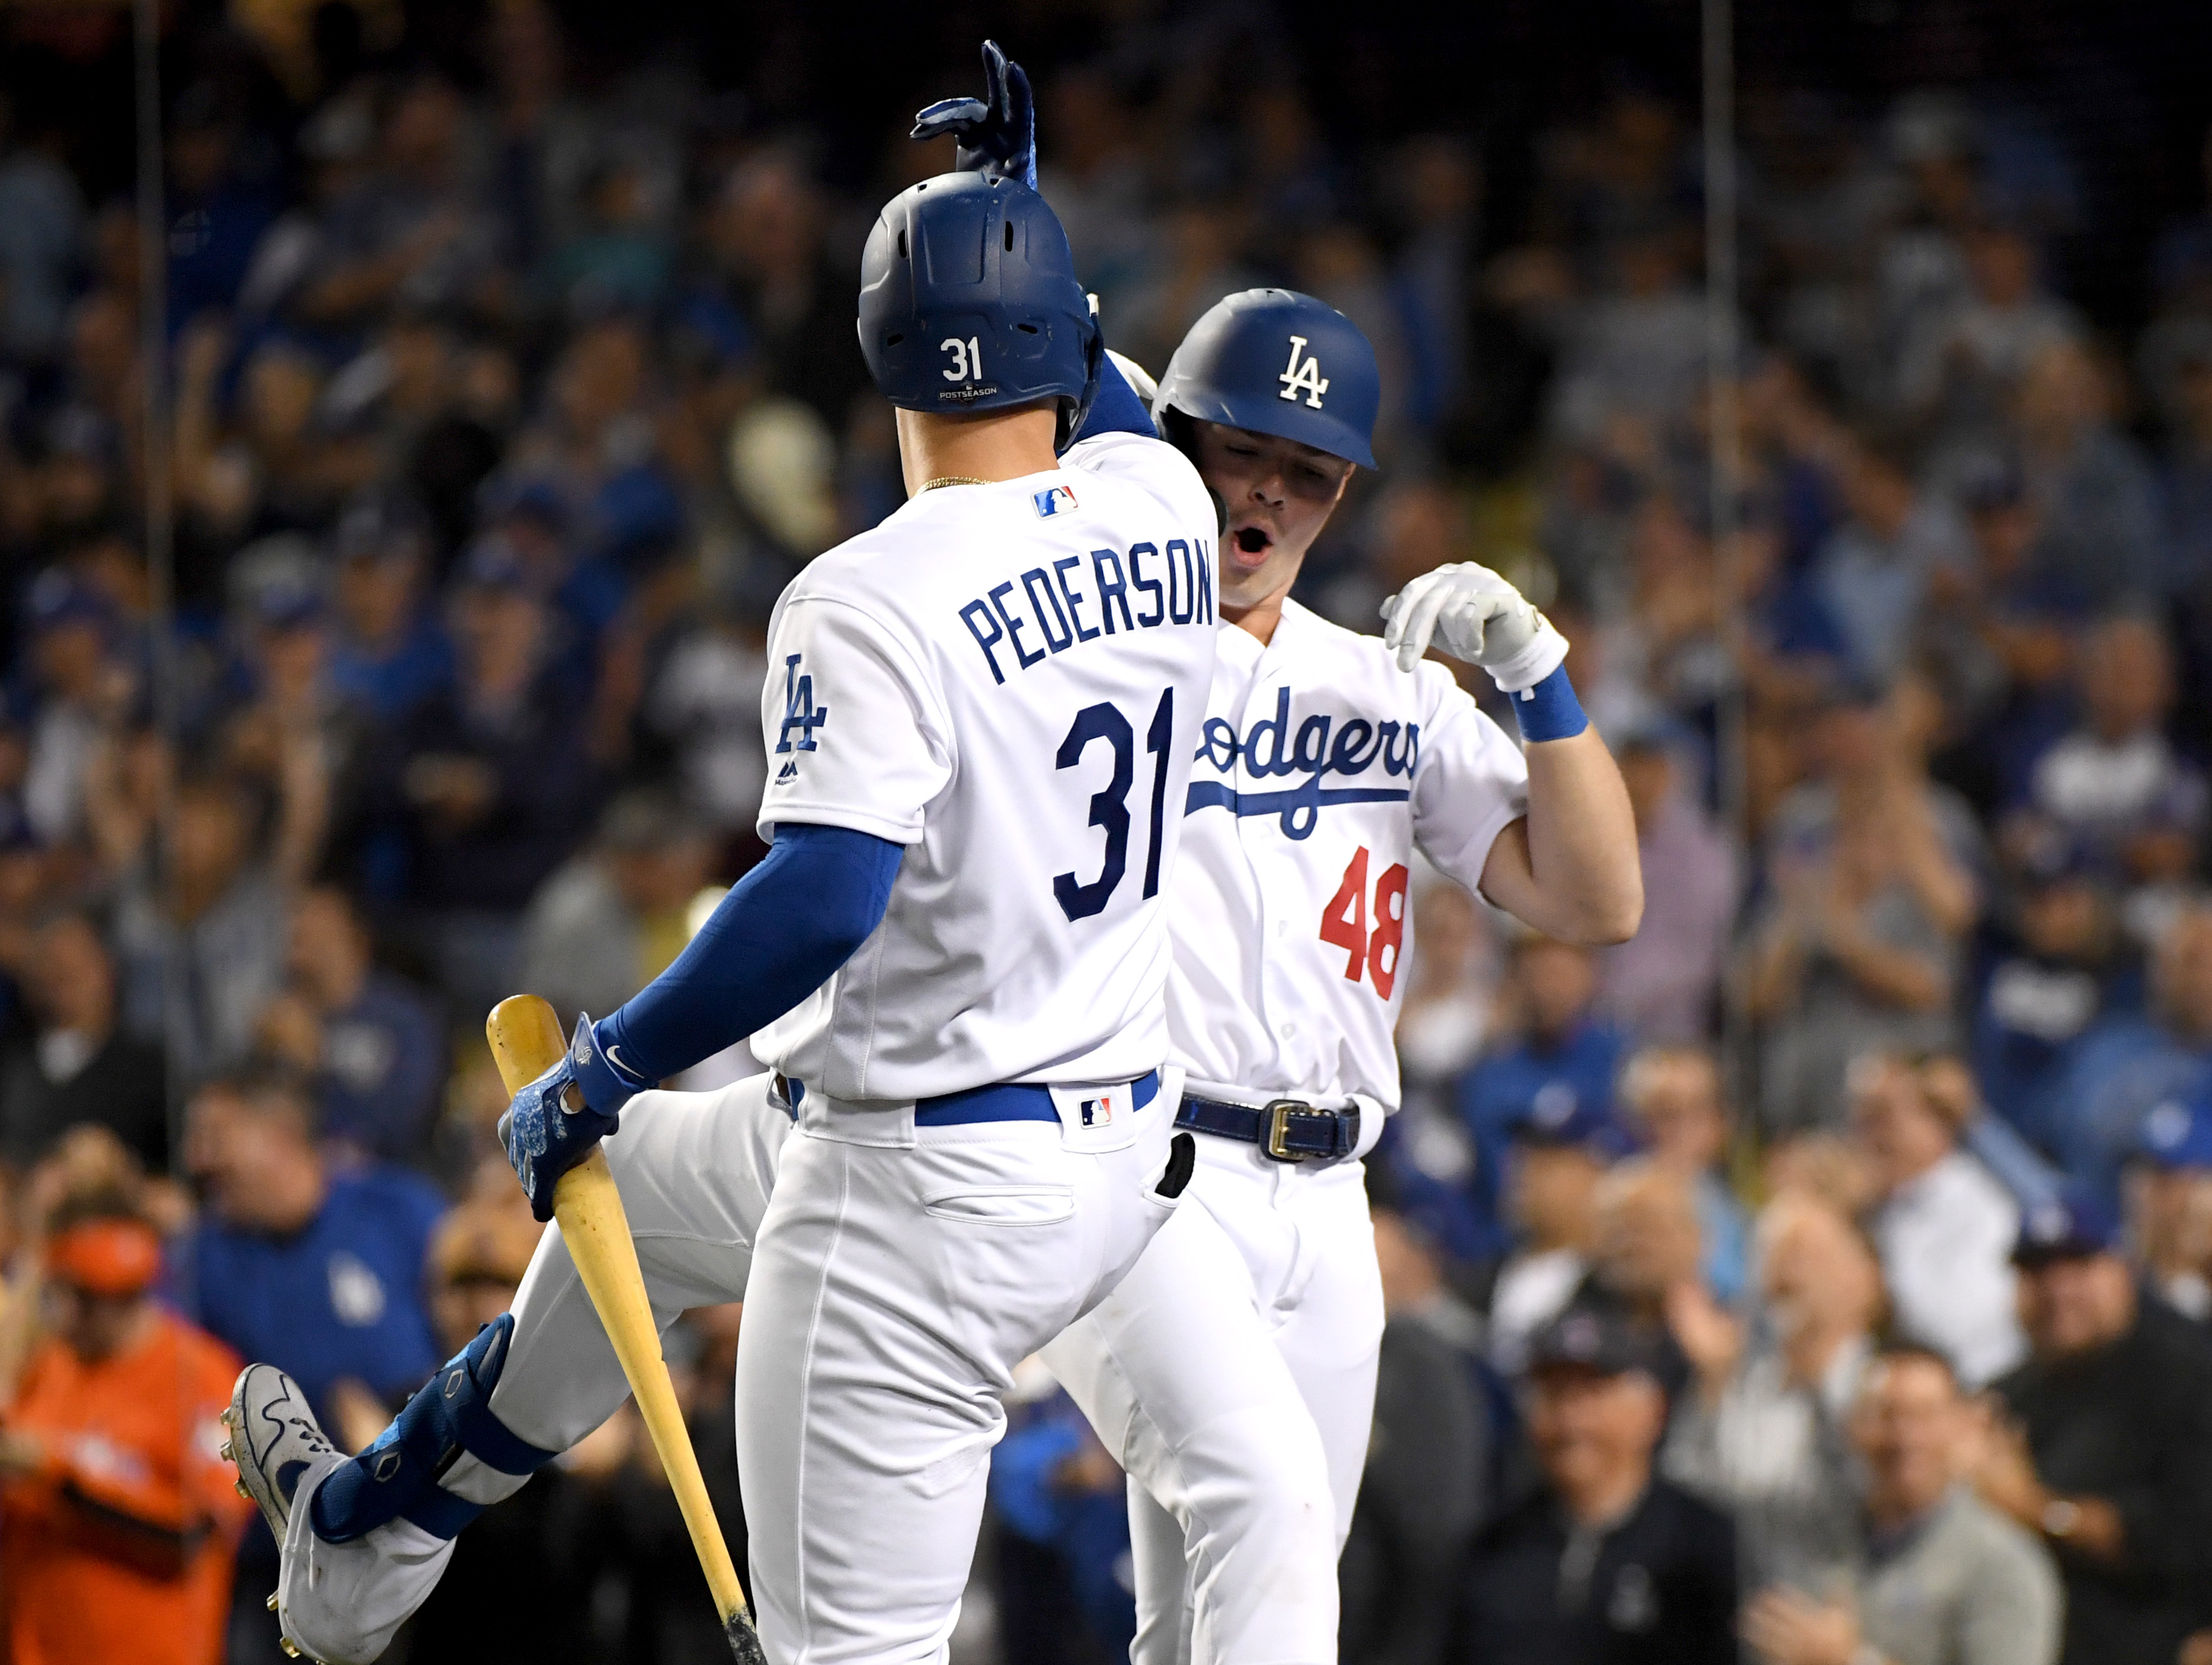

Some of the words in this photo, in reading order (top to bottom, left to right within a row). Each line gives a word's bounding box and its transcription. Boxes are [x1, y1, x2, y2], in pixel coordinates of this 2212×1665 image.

[940, 336, 982, 381] 31
[940, 387, 997, 399] POSTSEASON
[1278, 335, 1330, 409] LA
[958, 538, 1212, 686] PEDERSON
[774, 653, 827, 754] LA
[1193, 686, 1420, 840] odgers
[1053, 686, 1174, 923] 31
[1319, 845, 1409, 1001] 48
